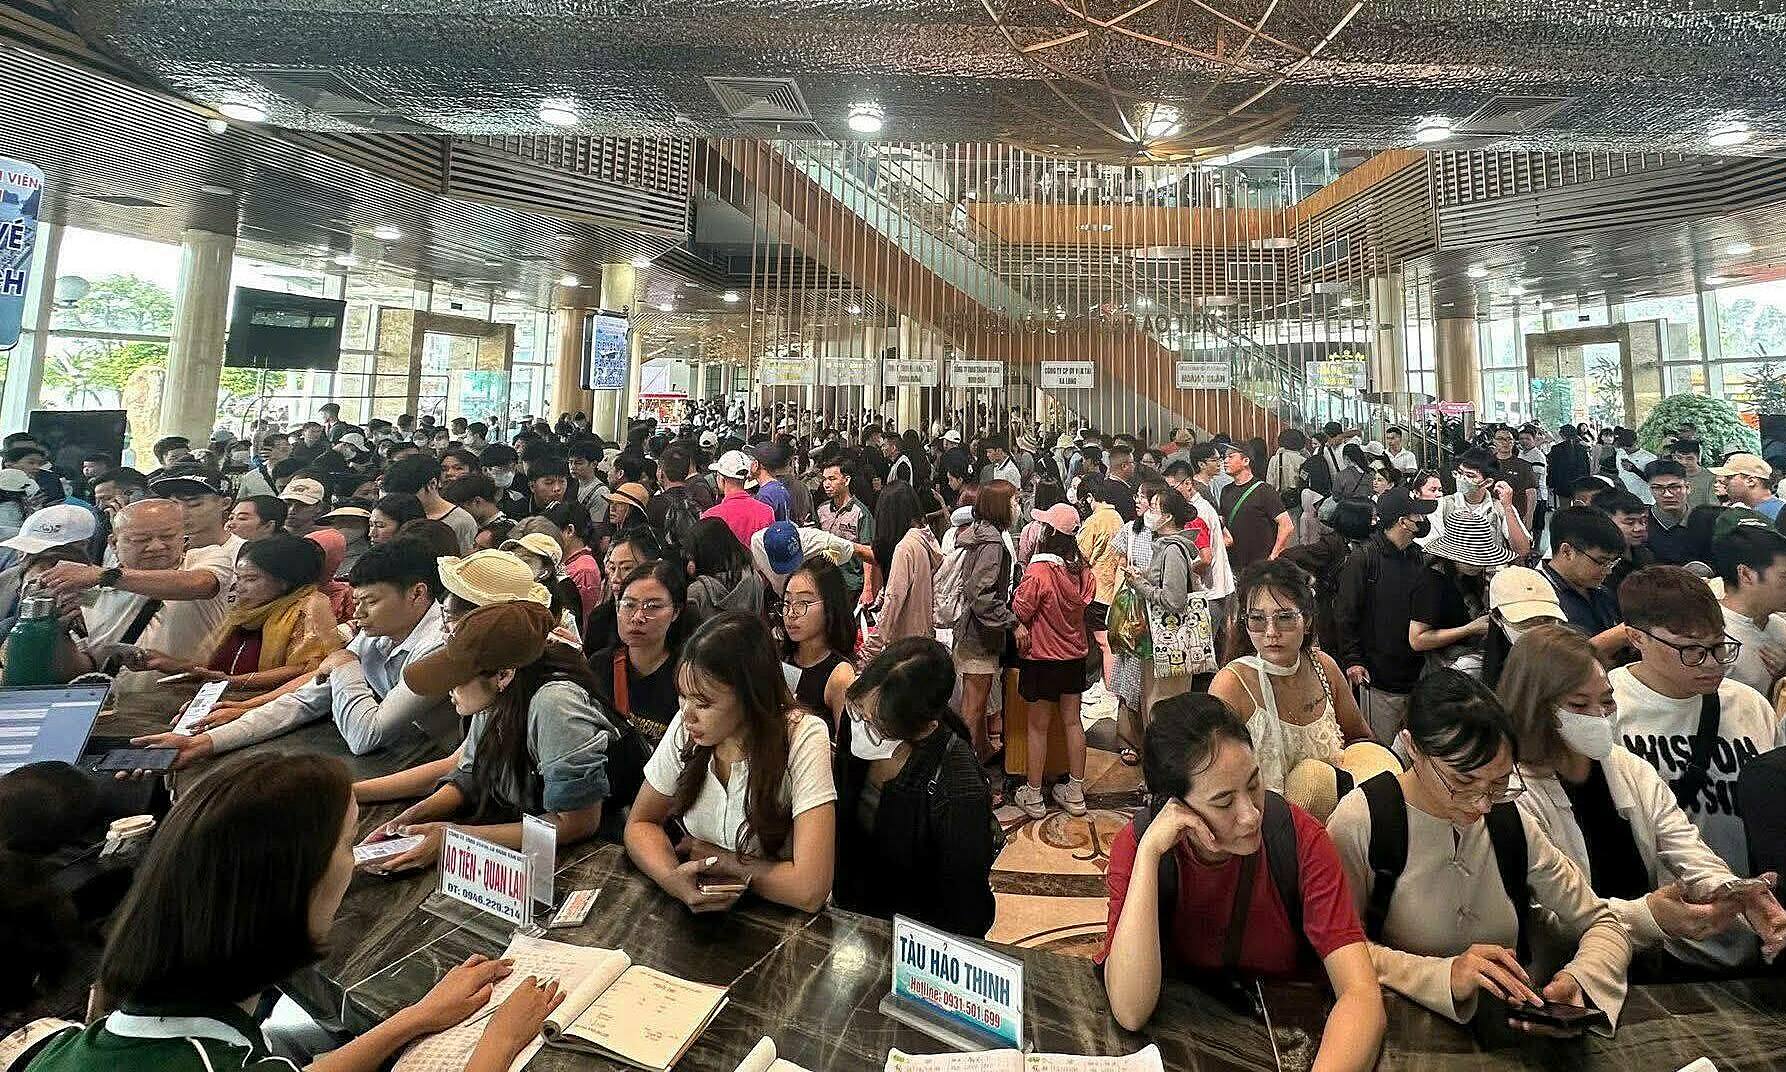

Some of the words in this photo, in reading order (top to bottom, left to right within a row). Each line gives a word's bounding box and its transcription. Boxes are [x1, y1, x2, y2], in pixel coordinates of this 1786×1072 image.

[8, 172, 39, 188] VIÊN
[446, 844, 457, 875] AO
[484, 858, 507, 895] QUAN
[900, 933, 926, 970] TÀU
[930, 942, 960, 985] HẢO
[964, 962, 1010, 1007] THỊNH
[910, 976, 942, 1003] Hotline:
